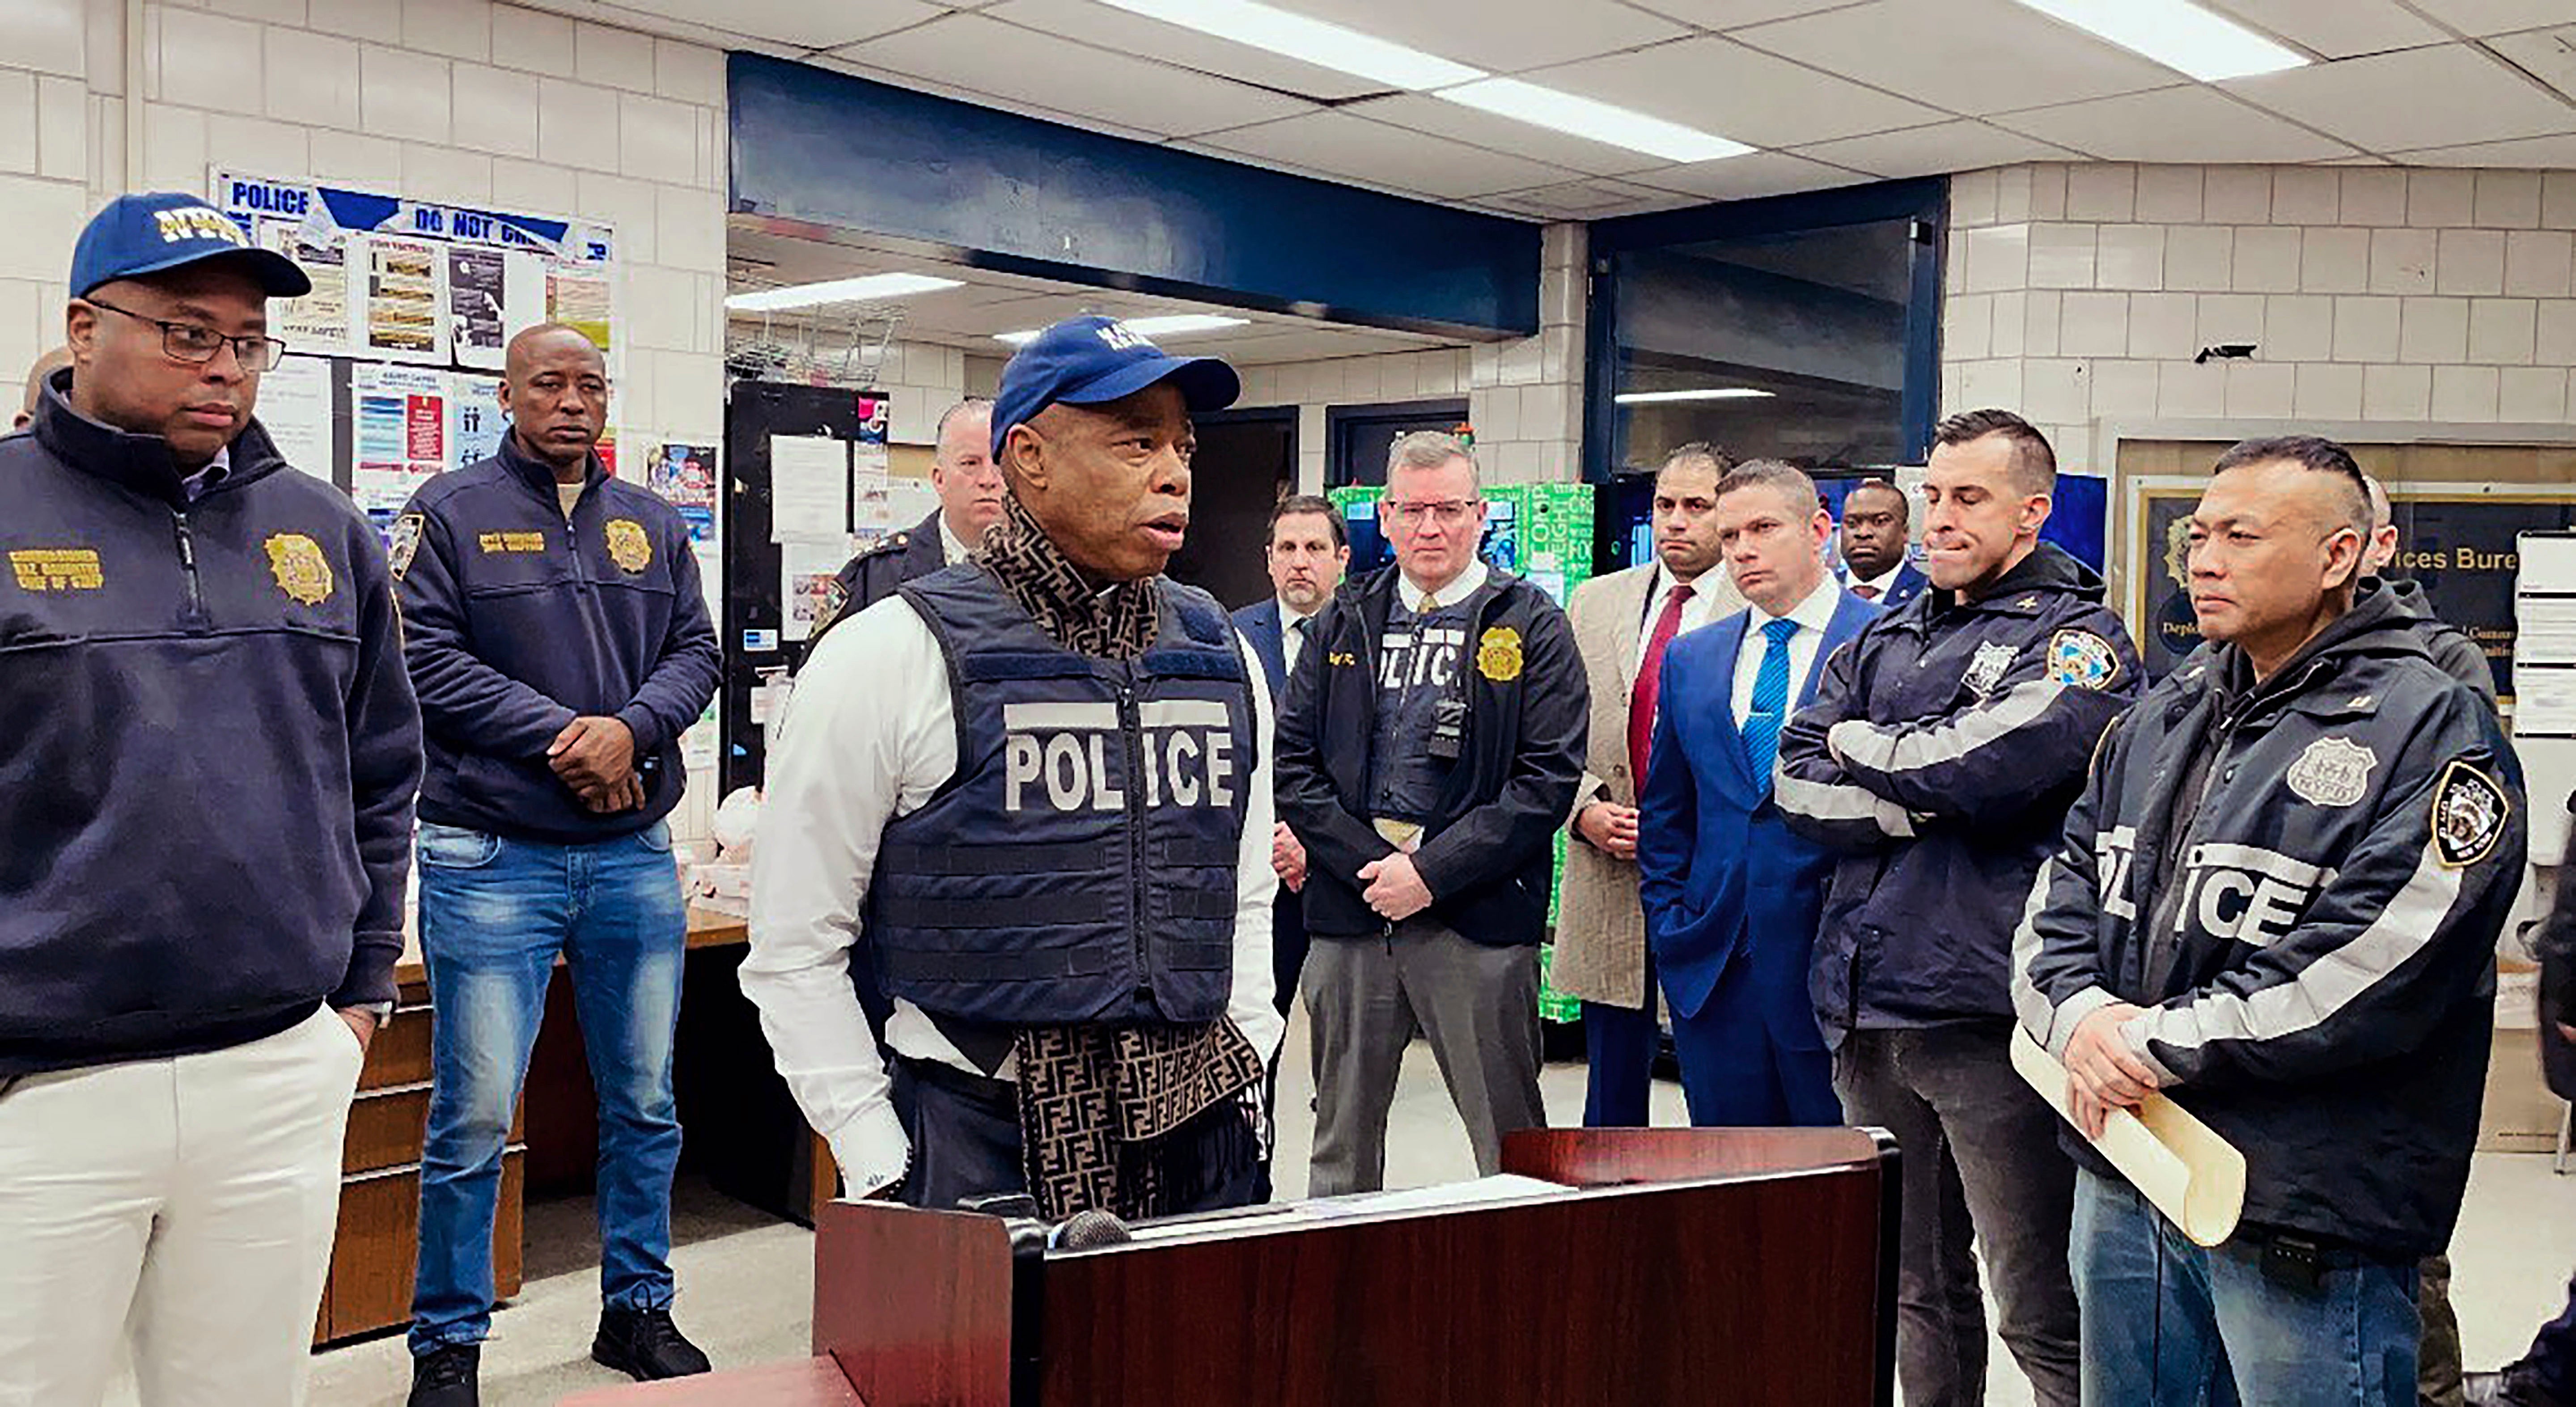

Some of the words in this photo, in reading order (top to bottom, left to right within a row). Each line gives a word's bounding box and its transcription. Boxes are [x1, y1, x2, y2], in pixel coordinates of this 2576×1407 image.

[233, 182, 309, 215] POLICE
[415, 208, 443, 232] DO
[453, 212, 493, 239] NOT
[2457, 547, 2517, 569] Bure
[1005, 729, 1233, 811] POLICE
